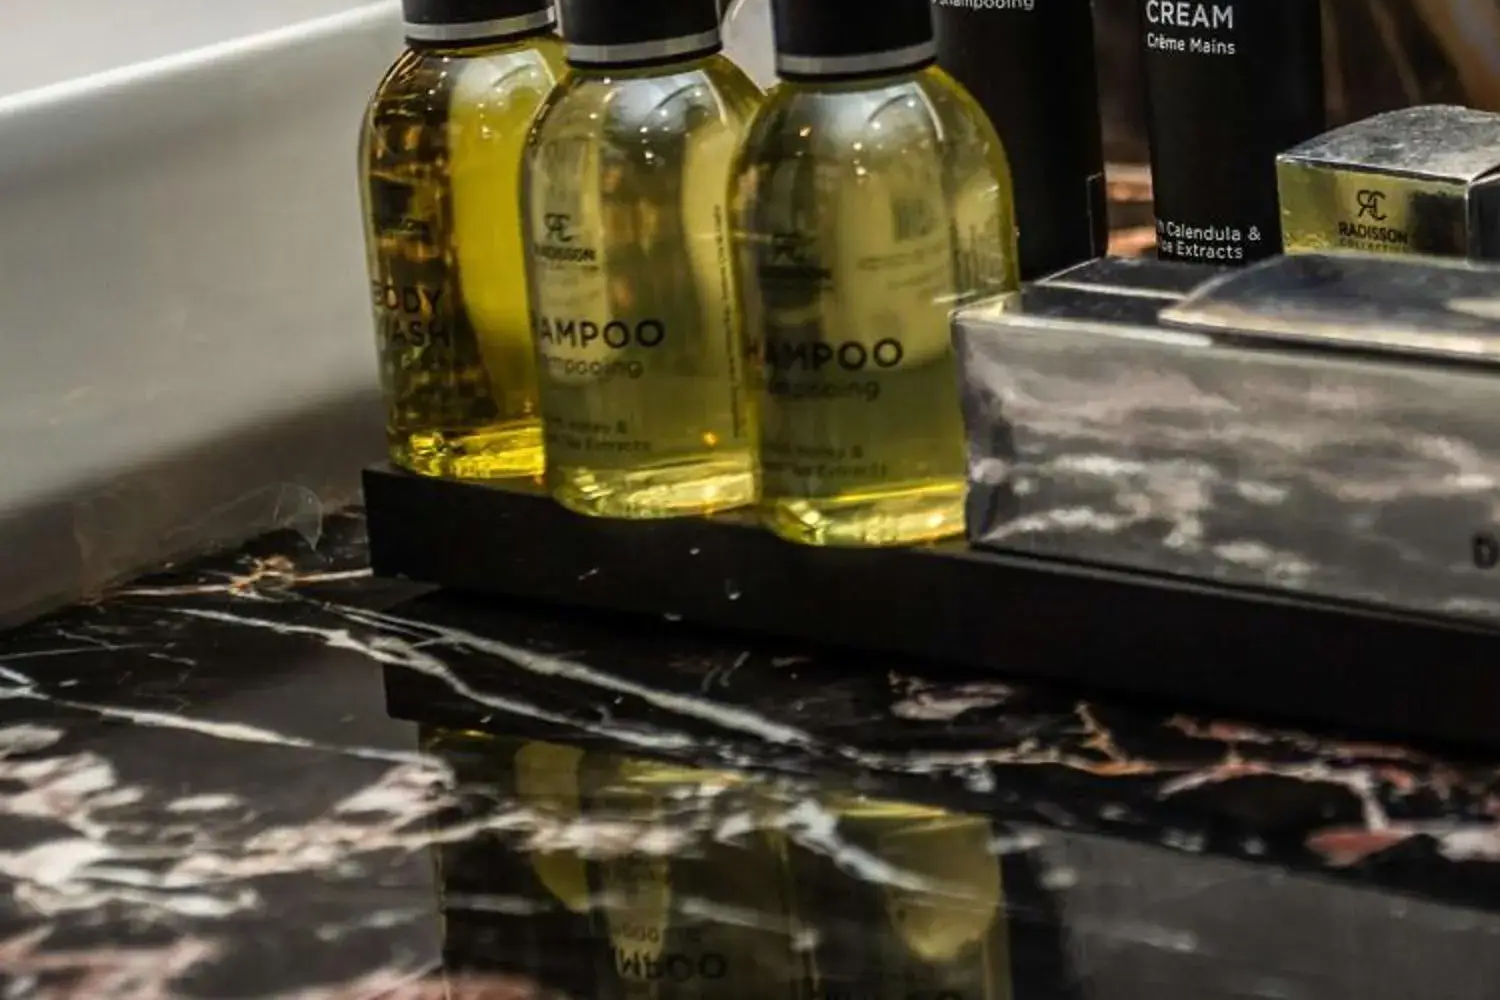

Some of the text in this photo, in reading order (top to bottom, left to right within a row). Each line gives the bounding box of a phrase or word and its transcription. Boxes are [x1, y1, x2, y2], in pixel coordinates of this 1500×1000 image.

[1146, 31, 1236, 55] Crème Mains
[1166, 221, 1241, 241] Calendula
[1247, 223, 1262, 241] &
[1337, 220, 1408, 244] RADISSON
[1175, 240, 1244, 259] Extracts
